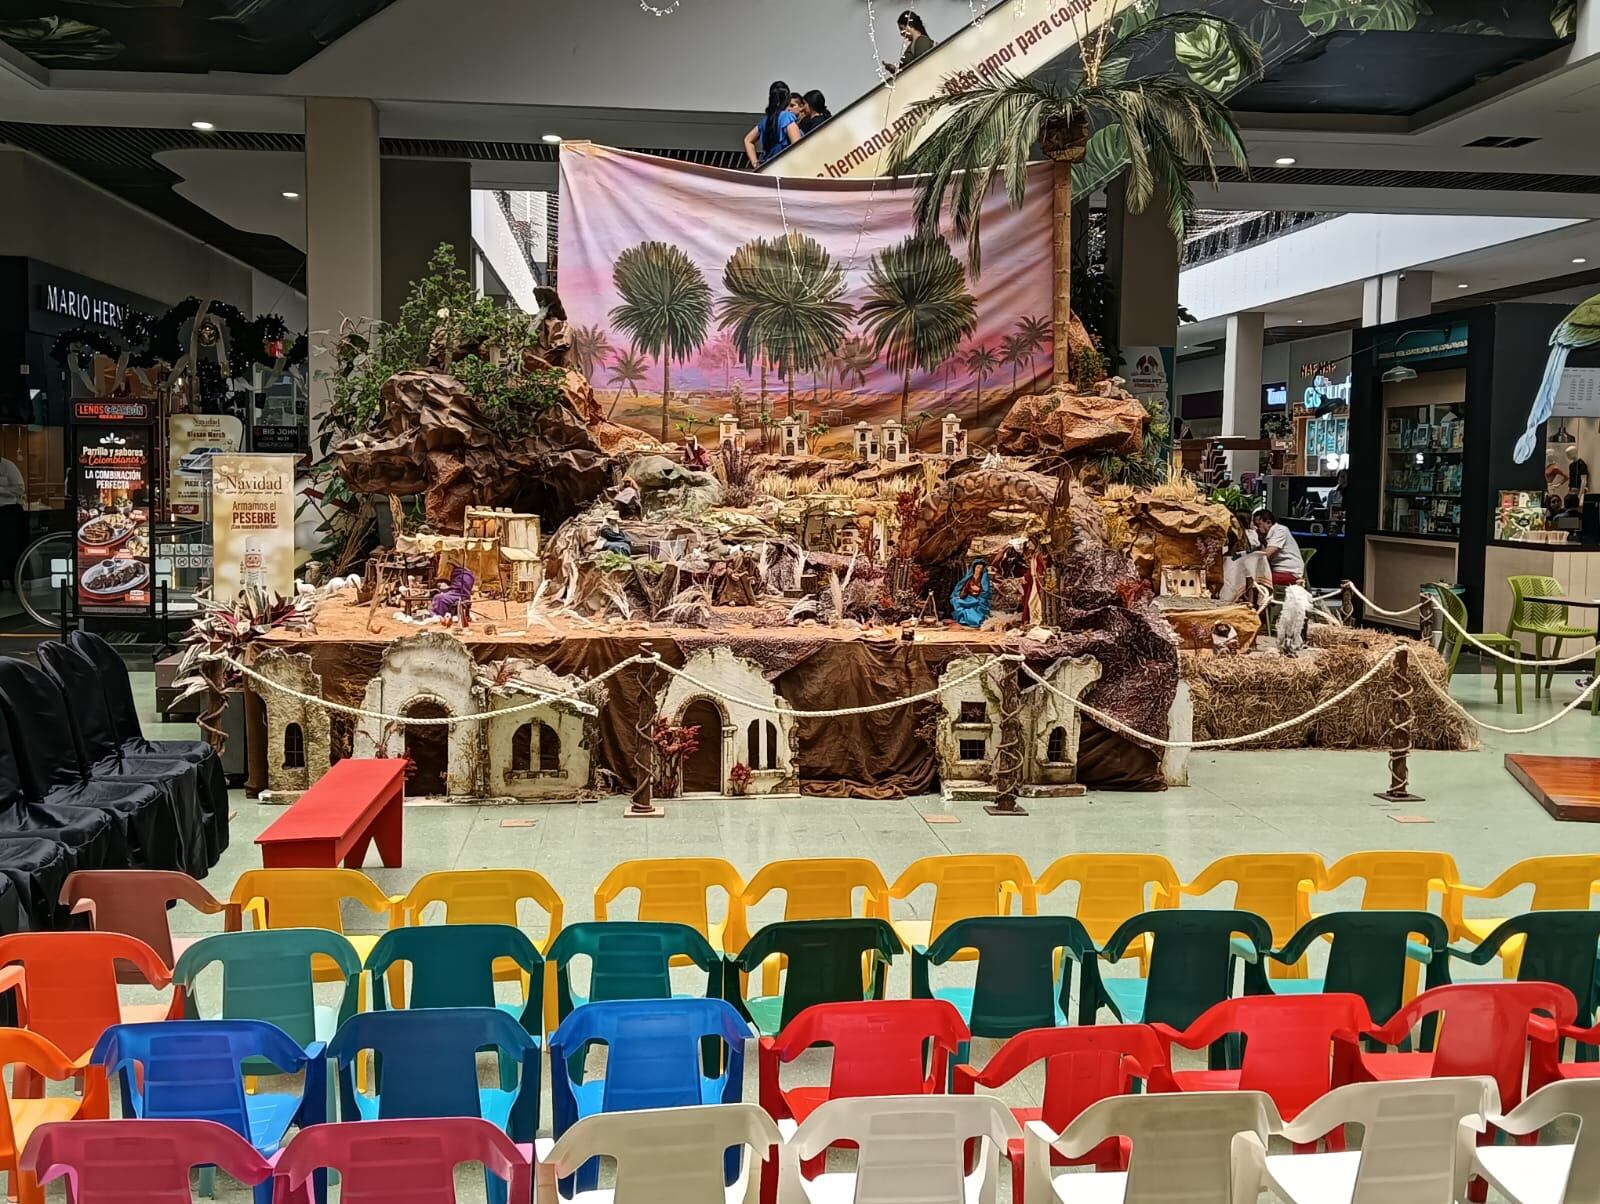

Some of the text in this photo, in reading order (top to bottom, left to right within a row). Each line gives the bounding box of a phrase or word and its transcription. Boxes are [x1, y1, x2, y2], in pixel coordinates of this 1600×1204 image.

[824, 128, 893, 178] hermano
[977, 42, 1017, 80] amor
[1015, 20, 1052, 55] para
[47, 284, 124, 328] MARIO HERN
[277, 428, 298, 436] JOHN
[82, 446, 144, 458] Parrilla y sabores
[85, 469, 142, 480] LA COMBINACIÓN
[96, 480, 130, 490] PERFECTA
[226, 475, 282, 490] Navidad
[232, 501, 277, 511] Armamos el
[232, 512, 276, 524] PESEBRE
